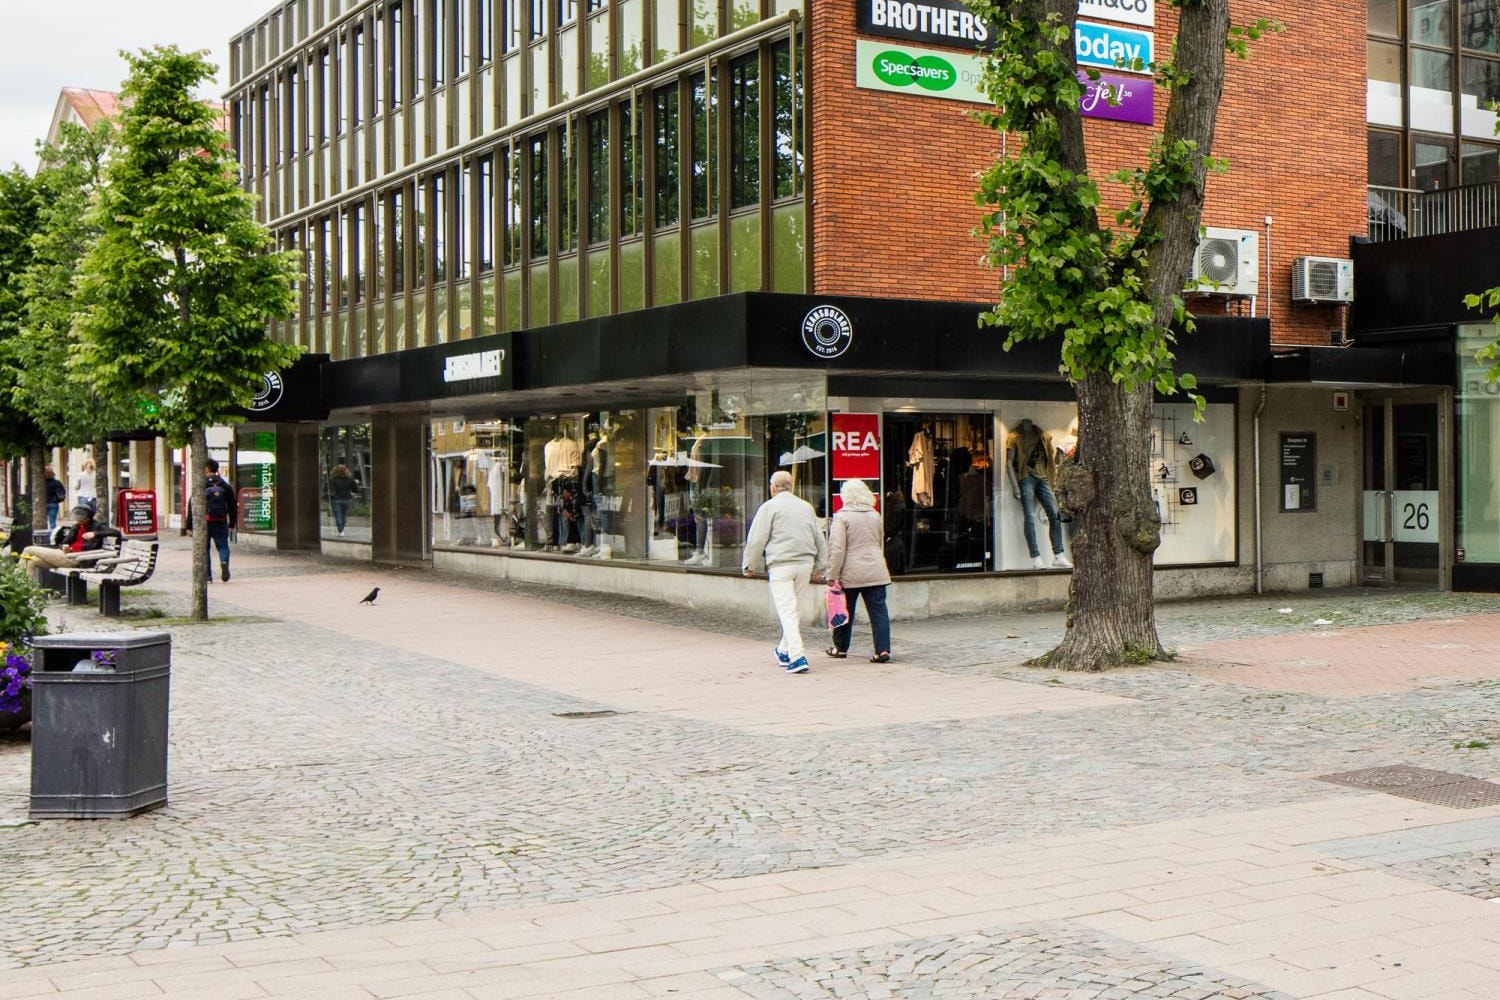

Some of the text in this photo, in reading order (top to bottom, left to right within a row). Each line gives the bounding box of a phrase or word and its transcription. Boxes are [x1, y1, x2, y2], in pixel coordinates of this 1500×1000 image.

[880, 59, 949, 80] Specsavers
[804, 308, 851, 337] JEANSBOLAGET
[831, 431, 879, 451] REA
[258, 461, 274, 520] ontaktlinser
[1403, 503, 1430, 530] 26
